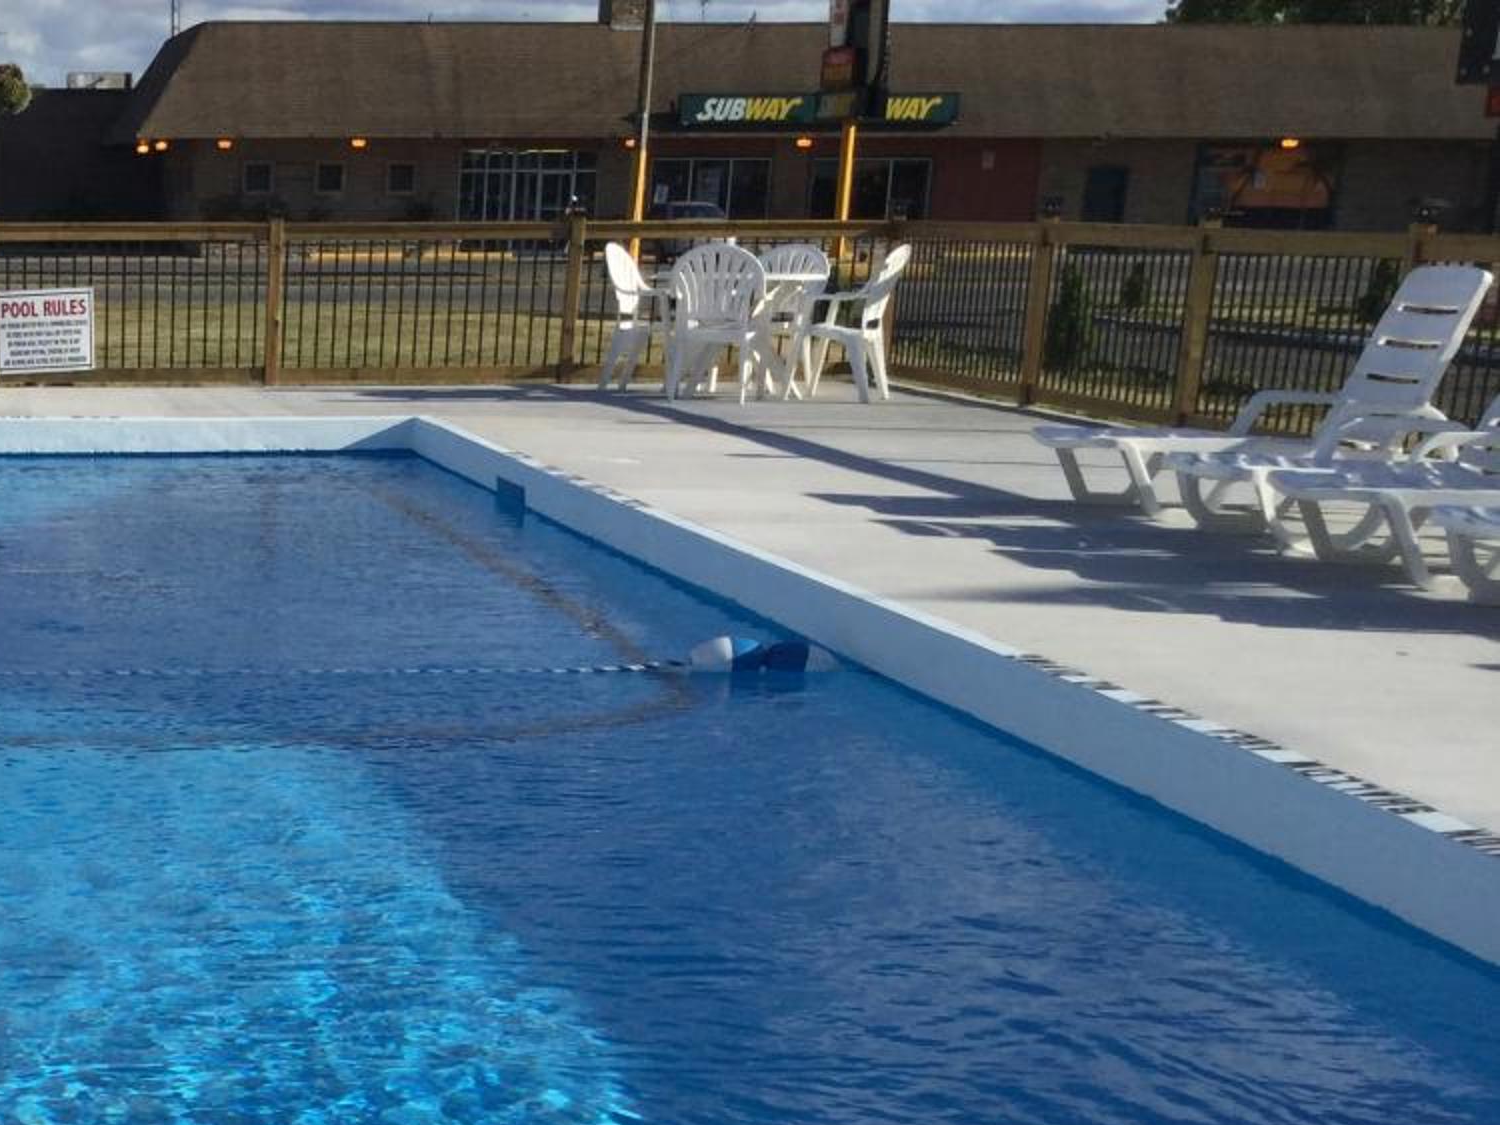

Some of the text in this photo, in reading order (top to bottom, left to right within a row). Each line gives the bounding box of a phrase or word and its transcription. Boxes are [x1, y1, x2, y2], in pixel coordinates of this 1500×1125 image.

[696, 97, 804, 121] SUBWAY
[1, 299, 87, 319] POOL RULES
